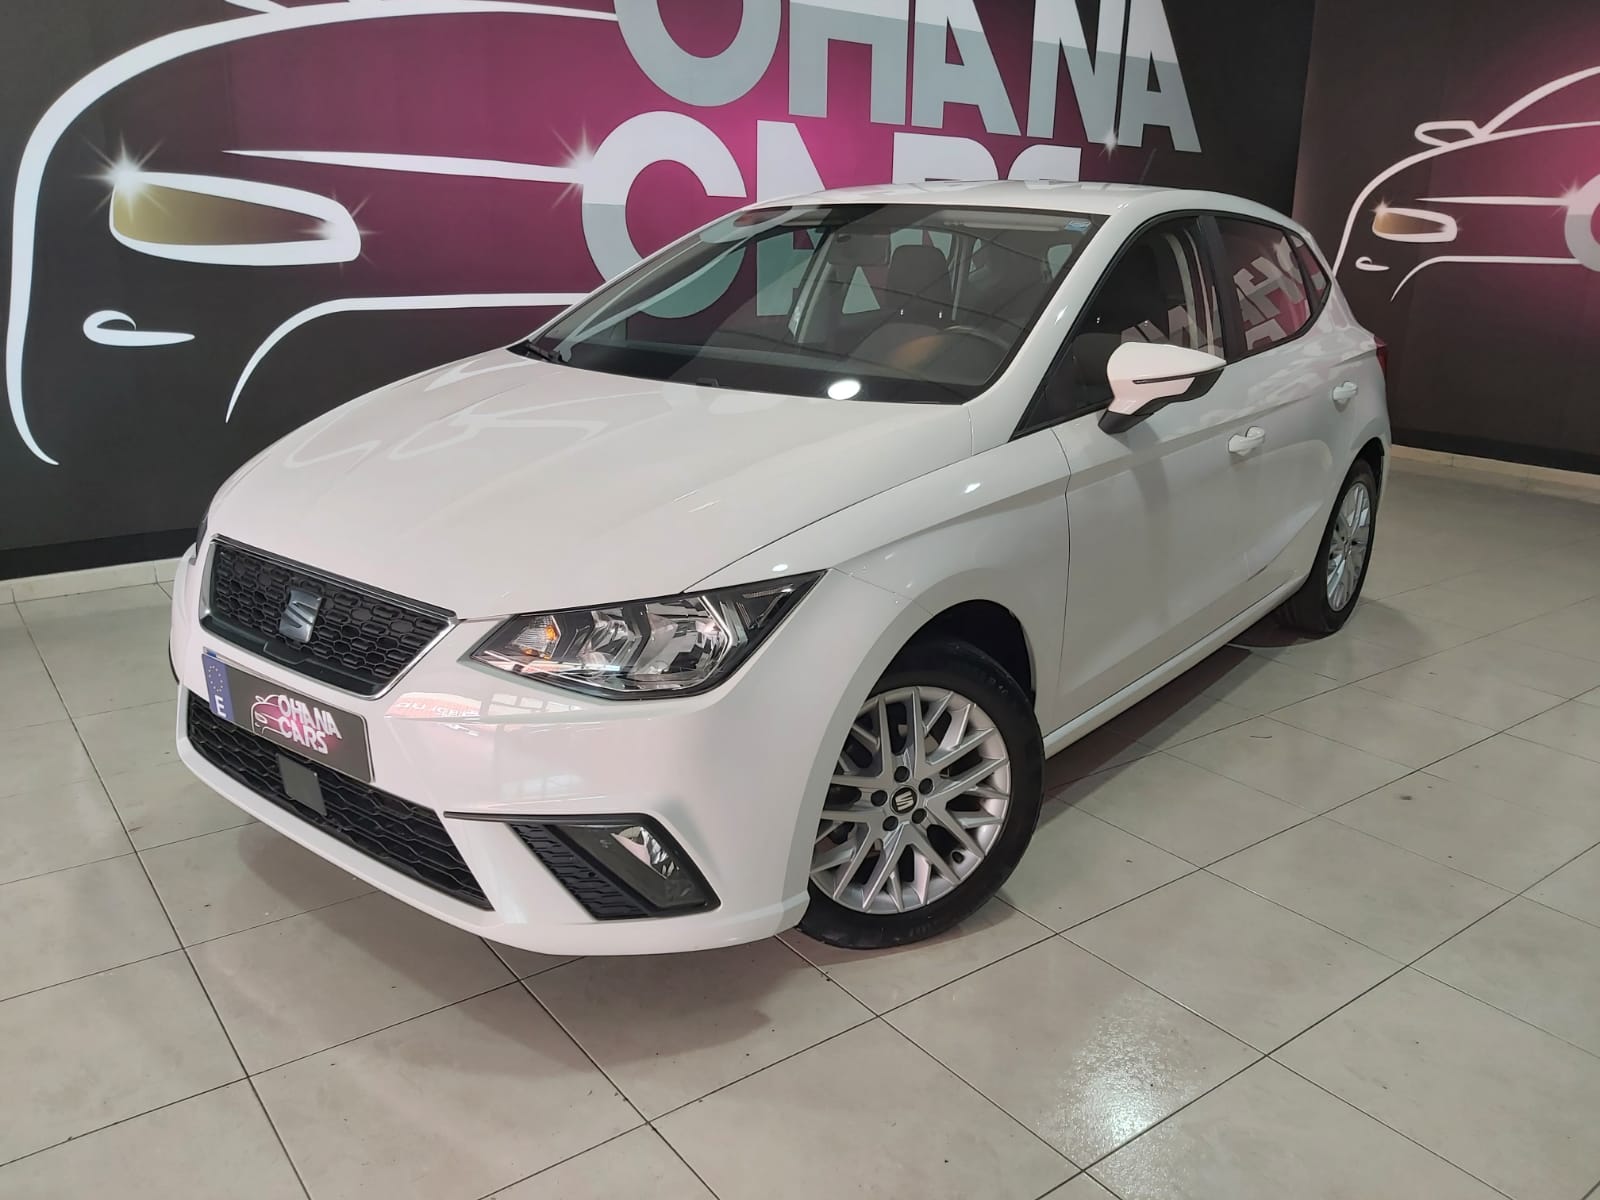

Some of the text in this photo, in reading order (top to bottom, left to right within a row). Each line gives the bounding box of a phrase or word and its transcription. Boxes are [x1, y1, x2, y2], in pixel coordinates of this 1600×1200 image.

[615, 0, 1202, 153] OHANA
[214, 694, 227, 719] E
[277, 694, 343, 740] OHANA
[278, 716, 329, 755] CARS
